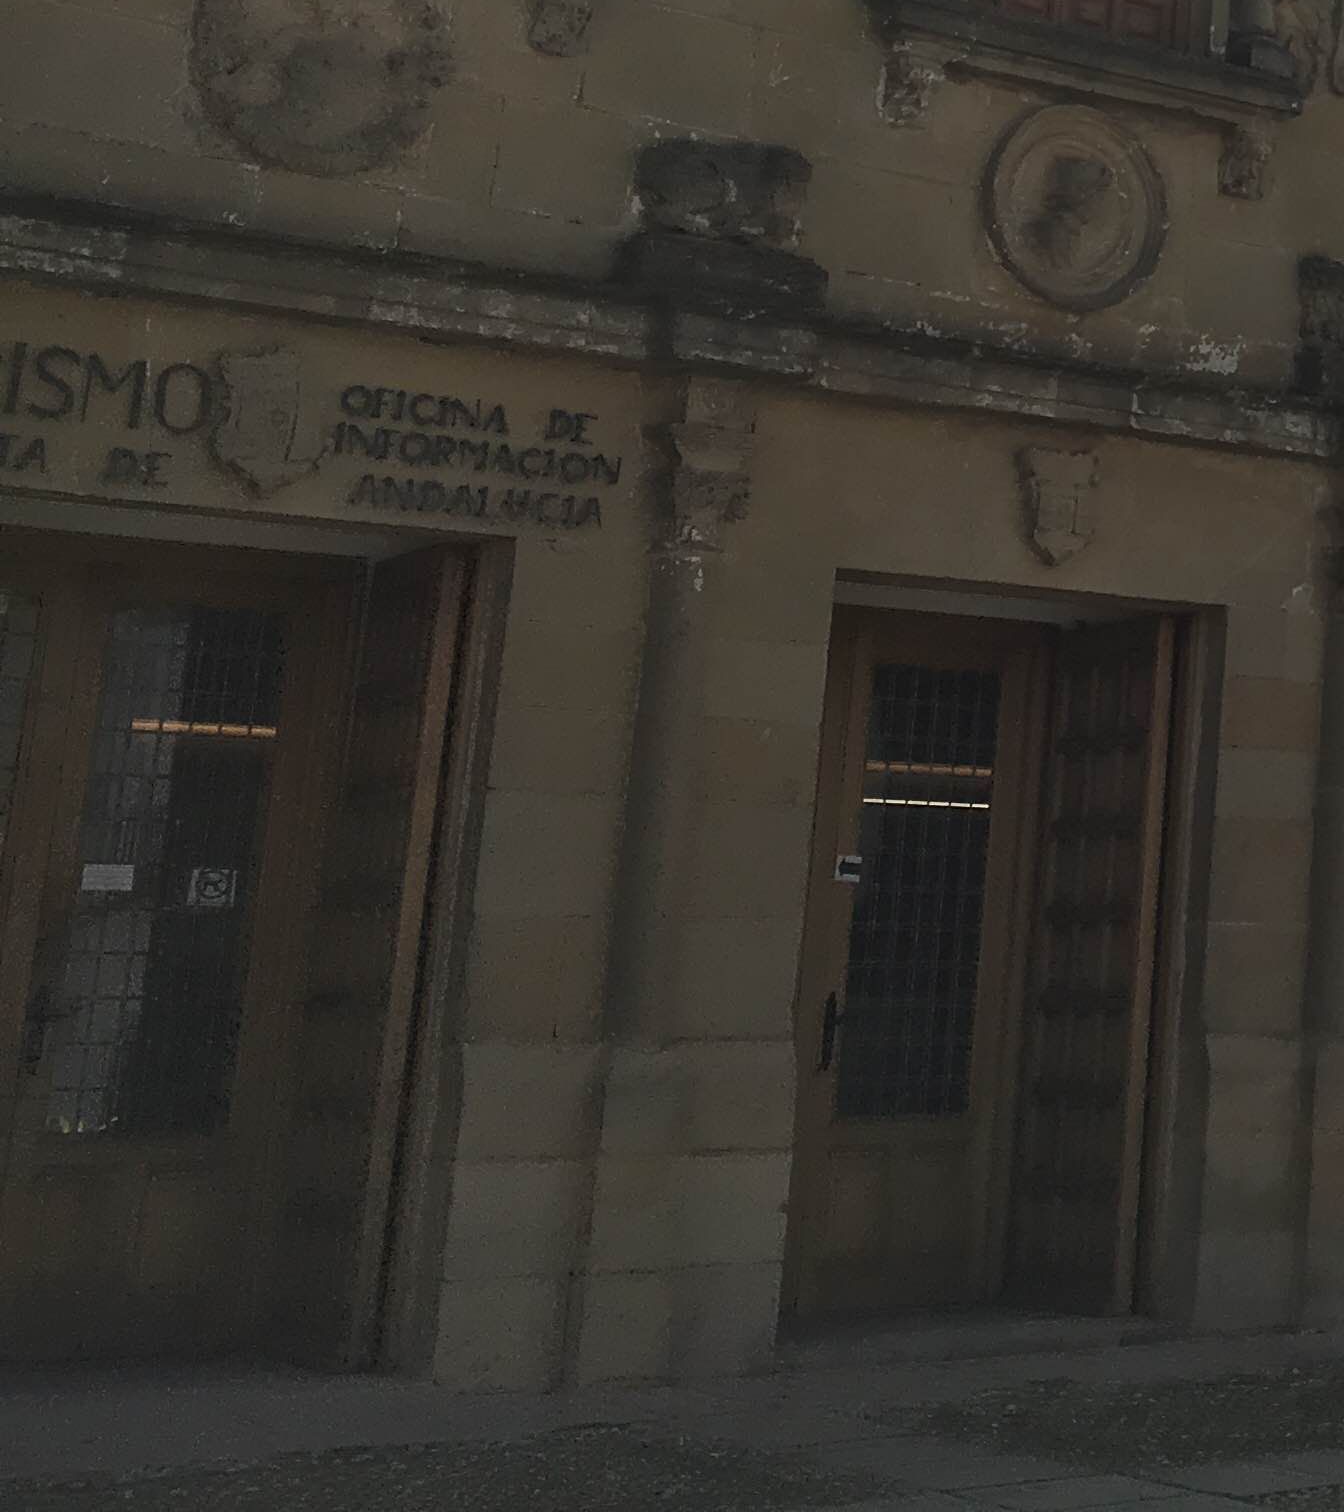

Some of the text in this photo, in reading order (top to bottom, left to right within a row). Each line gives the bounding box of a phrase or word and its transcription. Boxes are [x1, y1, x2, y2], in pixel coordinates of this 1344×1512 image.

[0, 341, 213, 434] ISMO
[340, 384, 598, 446] OFICINA DE
[98, 446, 174, 487] DE
[333, 420, 622, 486] INFORMACION
[347, 473, 603, 529] ANDALUCIA
